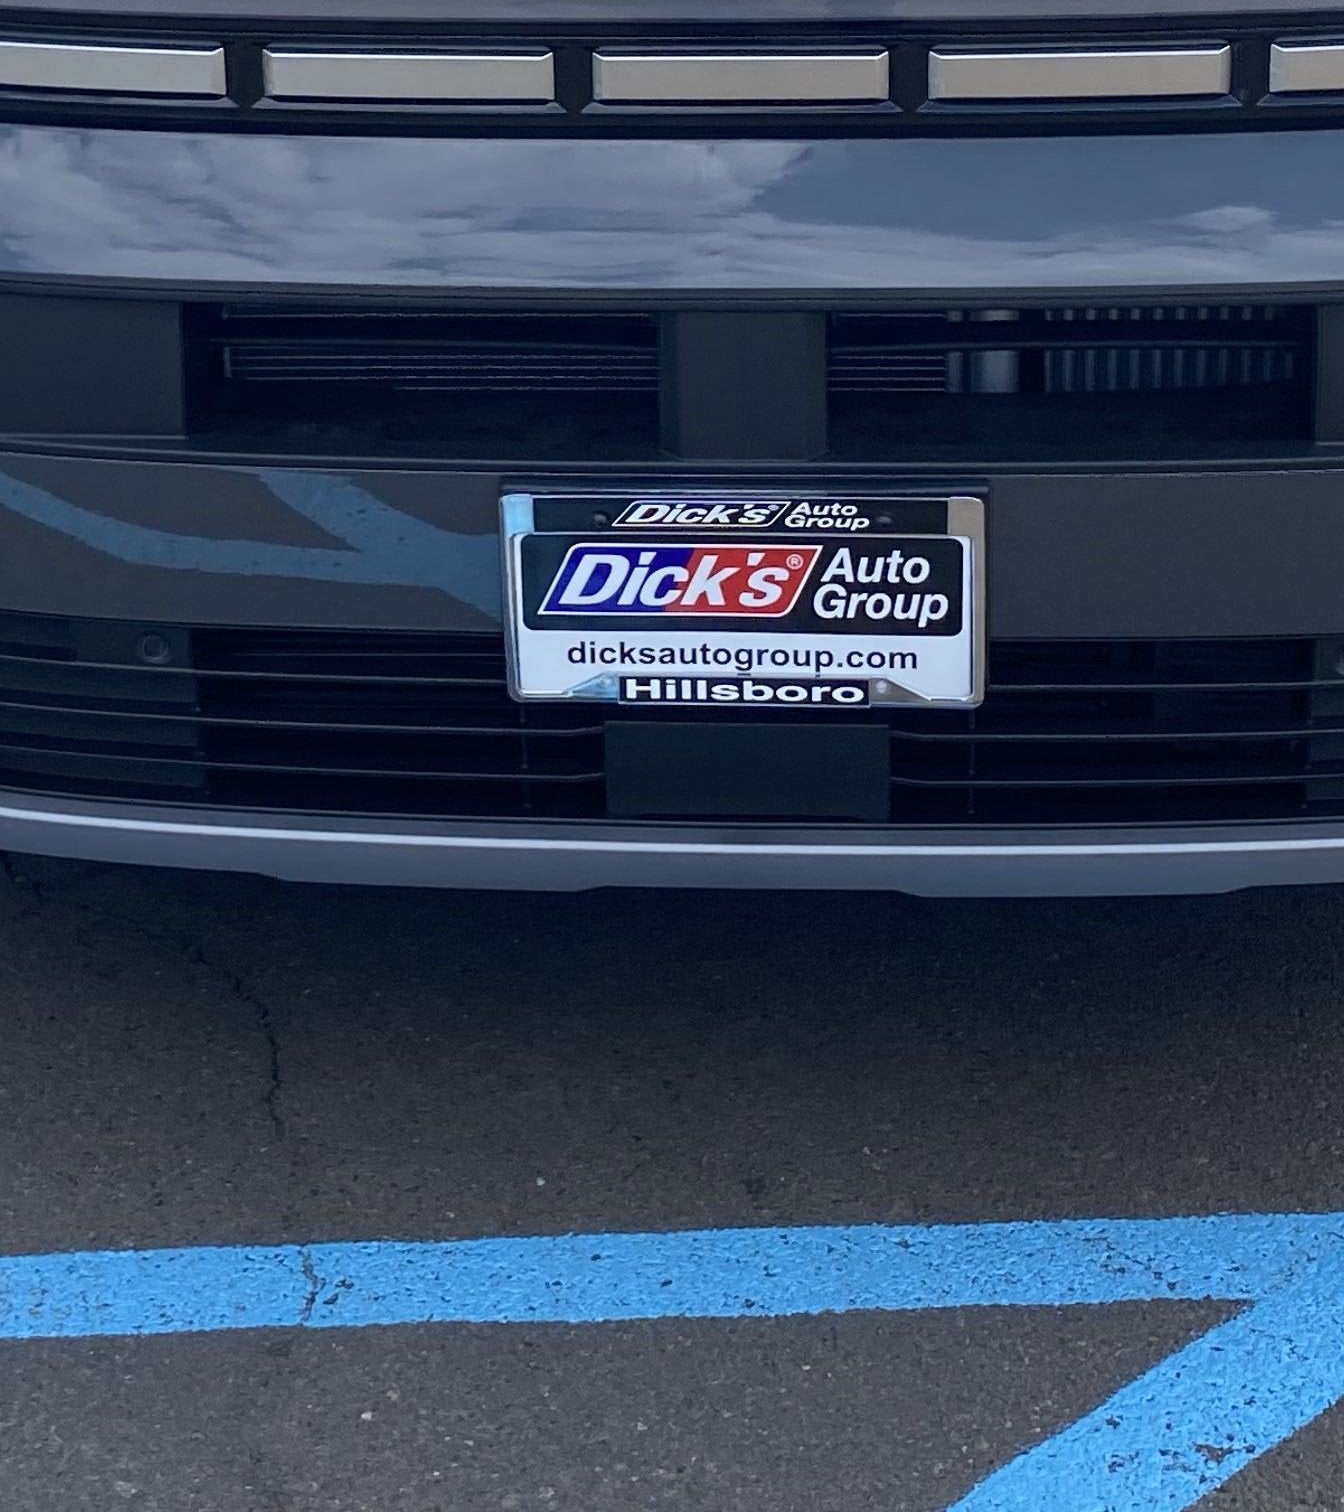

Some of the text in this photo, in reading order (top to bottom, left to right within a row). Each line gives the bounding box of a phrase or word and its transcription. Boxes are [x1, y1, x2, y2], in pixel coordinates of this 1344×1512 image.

[784, 514, 870, 531] Group
[790, 502, 858, 516] Auto
[820, 548, 931, 584] Auto
[813, 583, 949, 628] Group
[567, 641, 918, 676] dicksautogroup.com
[625, 678, 865, 703] Hillsboro
